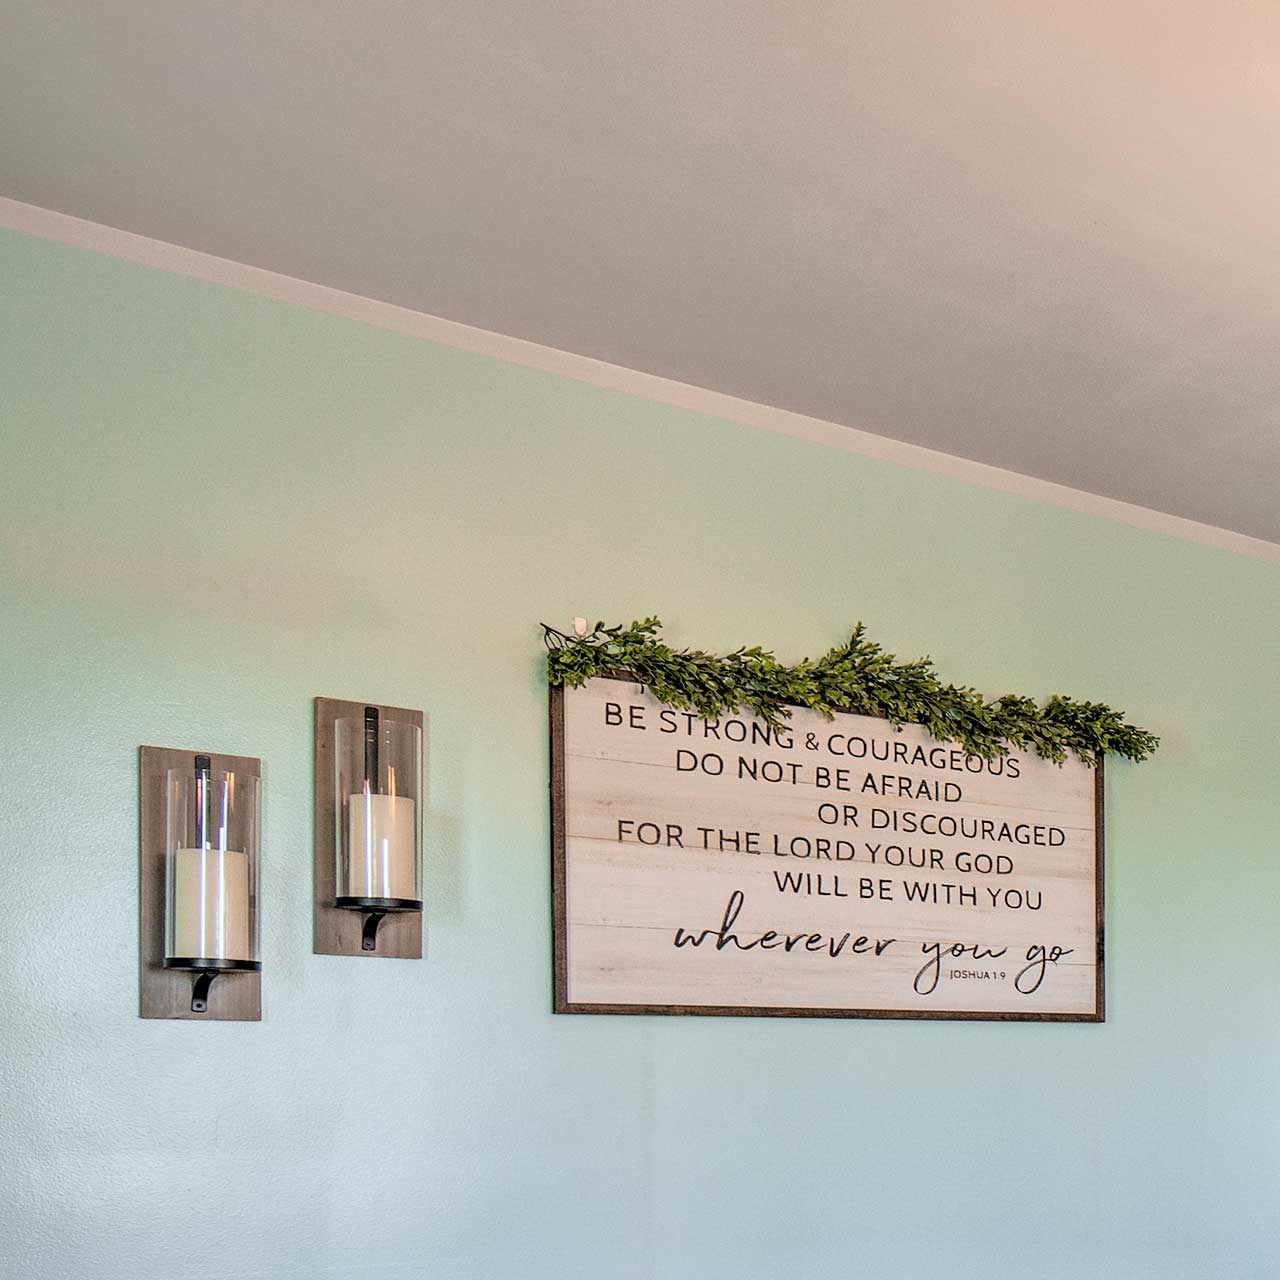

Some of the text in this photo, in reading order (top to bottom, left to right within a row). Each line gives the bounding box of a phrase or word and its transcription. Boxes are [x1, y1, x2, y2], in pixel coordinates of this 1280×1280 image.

[604, 703, 1021, 778] BE STRONG & COURAGEOUS
[676, 750, 962, 802] DO NOT BE AFRAID
[617, 820, 1014, 875] FOR THE LORD YOUR GOD
[818, 803, 1066, 847] OR DISCOURAGED
[774, 871, 1043, 910] WILL BE WITH YOU
[674, 890, 1073, 995] wherever you go
[949, 969, 990, 981] JOSHUA
